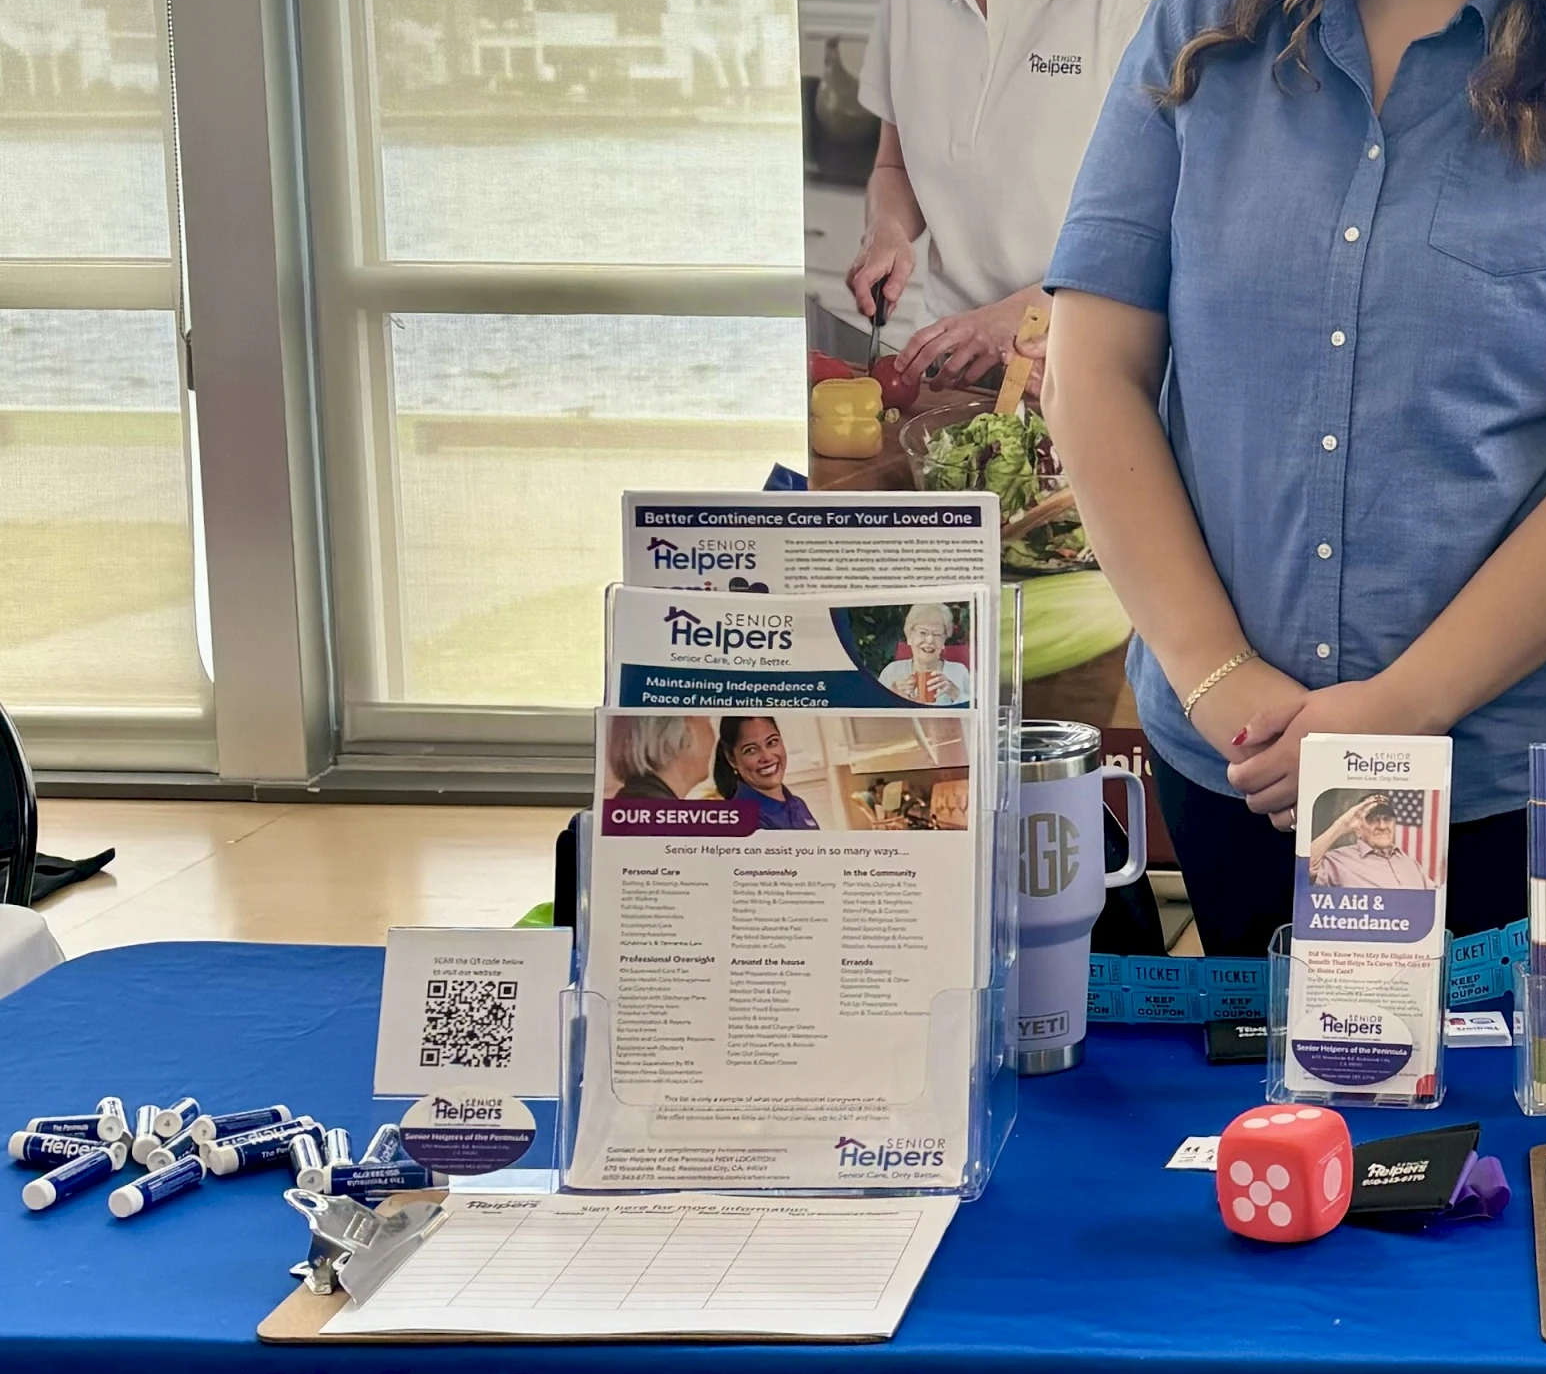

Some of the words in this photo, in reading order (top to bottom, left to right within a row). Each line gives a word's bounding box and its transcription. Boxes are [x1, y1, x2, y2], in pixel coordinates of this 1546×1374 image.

[1031, 59, 1082, 77] Helpers
[644, 512, 694, 526] Better
[698, 512, 784, 526] Continence
[787, 512, 823, 526] Care
[827, 512, 850, 526] For
[855, 512, 889, 526] Your
[893, 511, 938, 526] Loved
[942, 512, 972, 526] One
[698, 539, 756, 552] SENIOR
[654, 547, 757, 574] Helpers
[724, 612, 793, 628] SENIOR
[671, 623, 793, 654] Helpers
[646, 676, 724, 692] Maintaining
[726, 678, 813, 692] Independence
[816, 680, 827, 691] &
[642, 692, 677, 705] Peace
[678, 693, 698, 706] of
[700, 694, 732, 706] Mind
[735, 695, 762, 707] with
[765, 695, 829, 708] StackCare
[1347, 758, 1410, 775] Helpers
[611, 809, 652, 824] OUR
[655, 809, 739, 825] SERVICES
[734, 868, 798, 879] Companionship
[1310, 895, 1335, 911] VA
[1338, 895, 1369, 911] Aid
[1373, 896, 1385, 912] &
[1309, 913, 1410, 932] Attendance
[841, 958, 873, 966] Errands
[1135, 967, 1180, 981] TICKET
[1212, 970, 1257, 984] TICKET
[1145, 995, 1175, 1004] KEEP
[1221, 997, 1252, 1006] KEEP
[1138, 1008, 1184, 1016] COUPON
[1214, 1009, 1261, 1018] COUPON
[1018, 1016, 1065, 1033] YETI
[1323, 1019, 1382, 1036] Helpers
[435, 1104, 502, 1122] Helpers
[886, 1138, 946, 1149] SENIOR
[839, 1145, 944, 1169] Helpers
